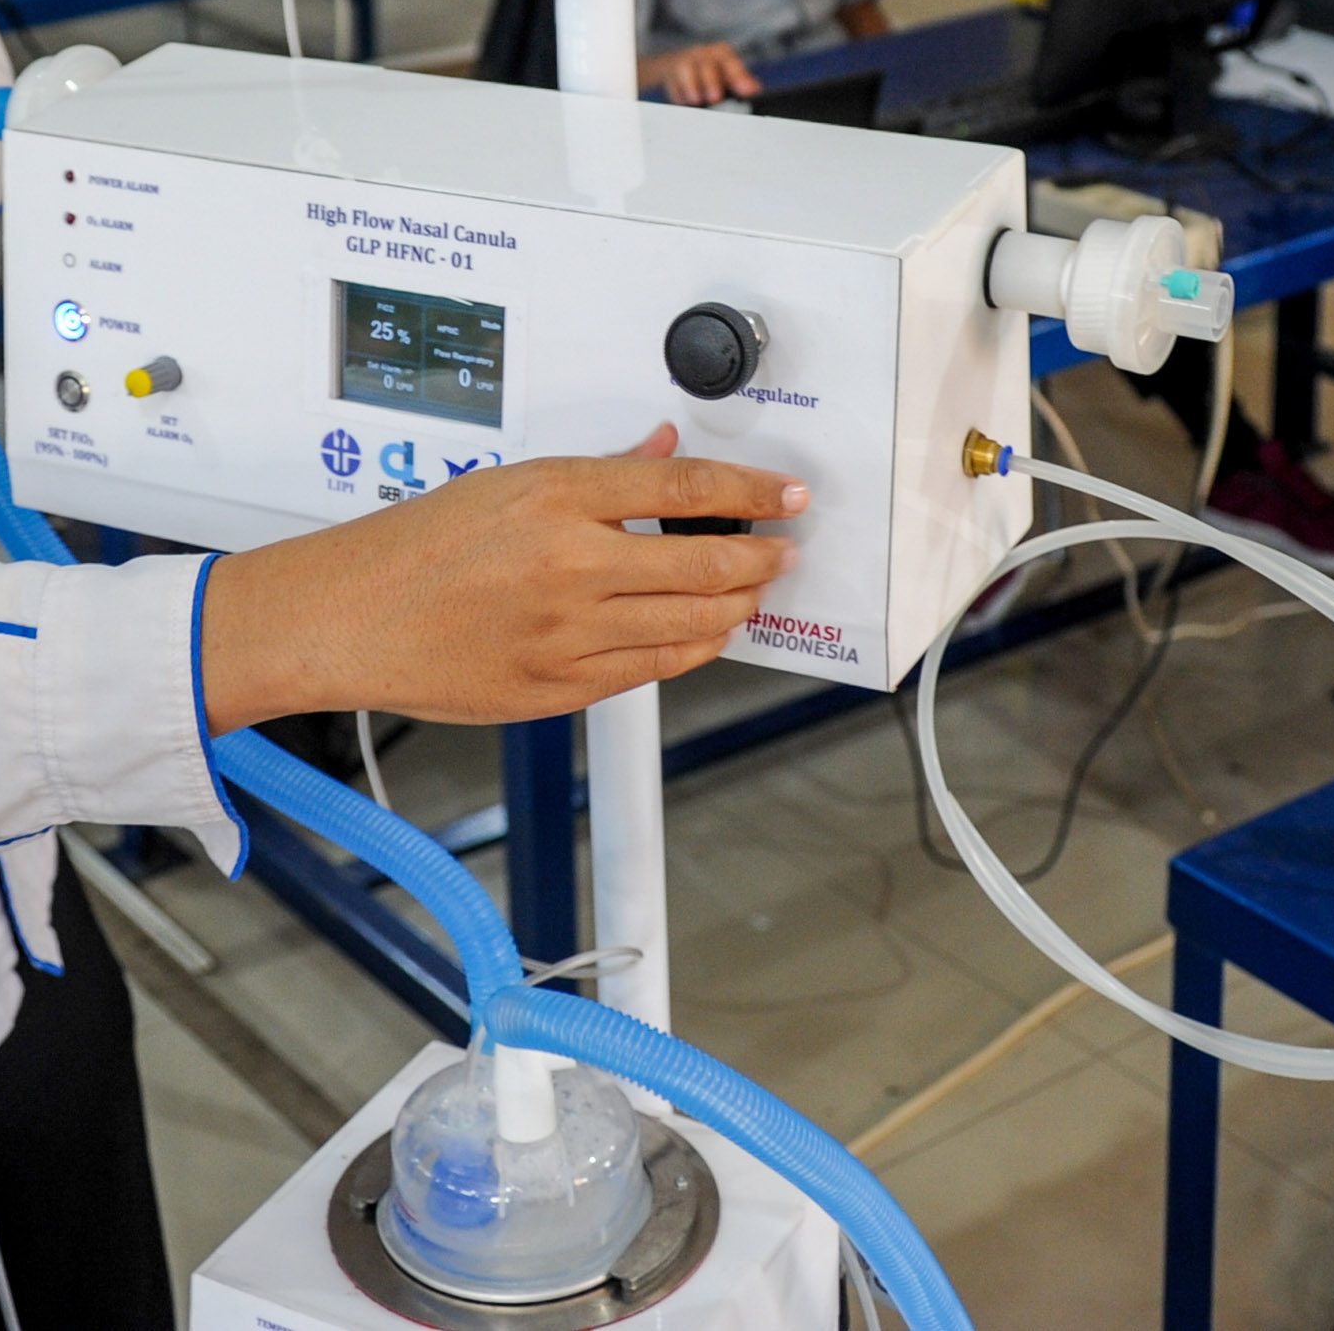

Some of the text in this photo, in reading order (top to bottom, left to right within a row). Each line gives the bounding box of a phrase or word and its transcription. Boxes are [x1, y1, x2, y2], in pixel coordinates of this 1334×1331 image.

[89, 175, 159, 194] POWER ALARM
[100, 218, 134, 231] ALARM
[306, 202, 517, 250] High Flow Nasal Canula
[346, 235, 381, 255] GLP
[386, 241, 436, 265] HFNC
[451, 251, 474, 271] 01
[89, 259, 122, 273] ALARM
[99, 317, 141, 334] POWER
[370, 320, 412, 346] 25 %
[383, 374, 395, 390] 0
[458, 368, 472, 388] 0
[327, 477, 355, 495] LIPI
[750, 628, 859, 664] INDONESIA
